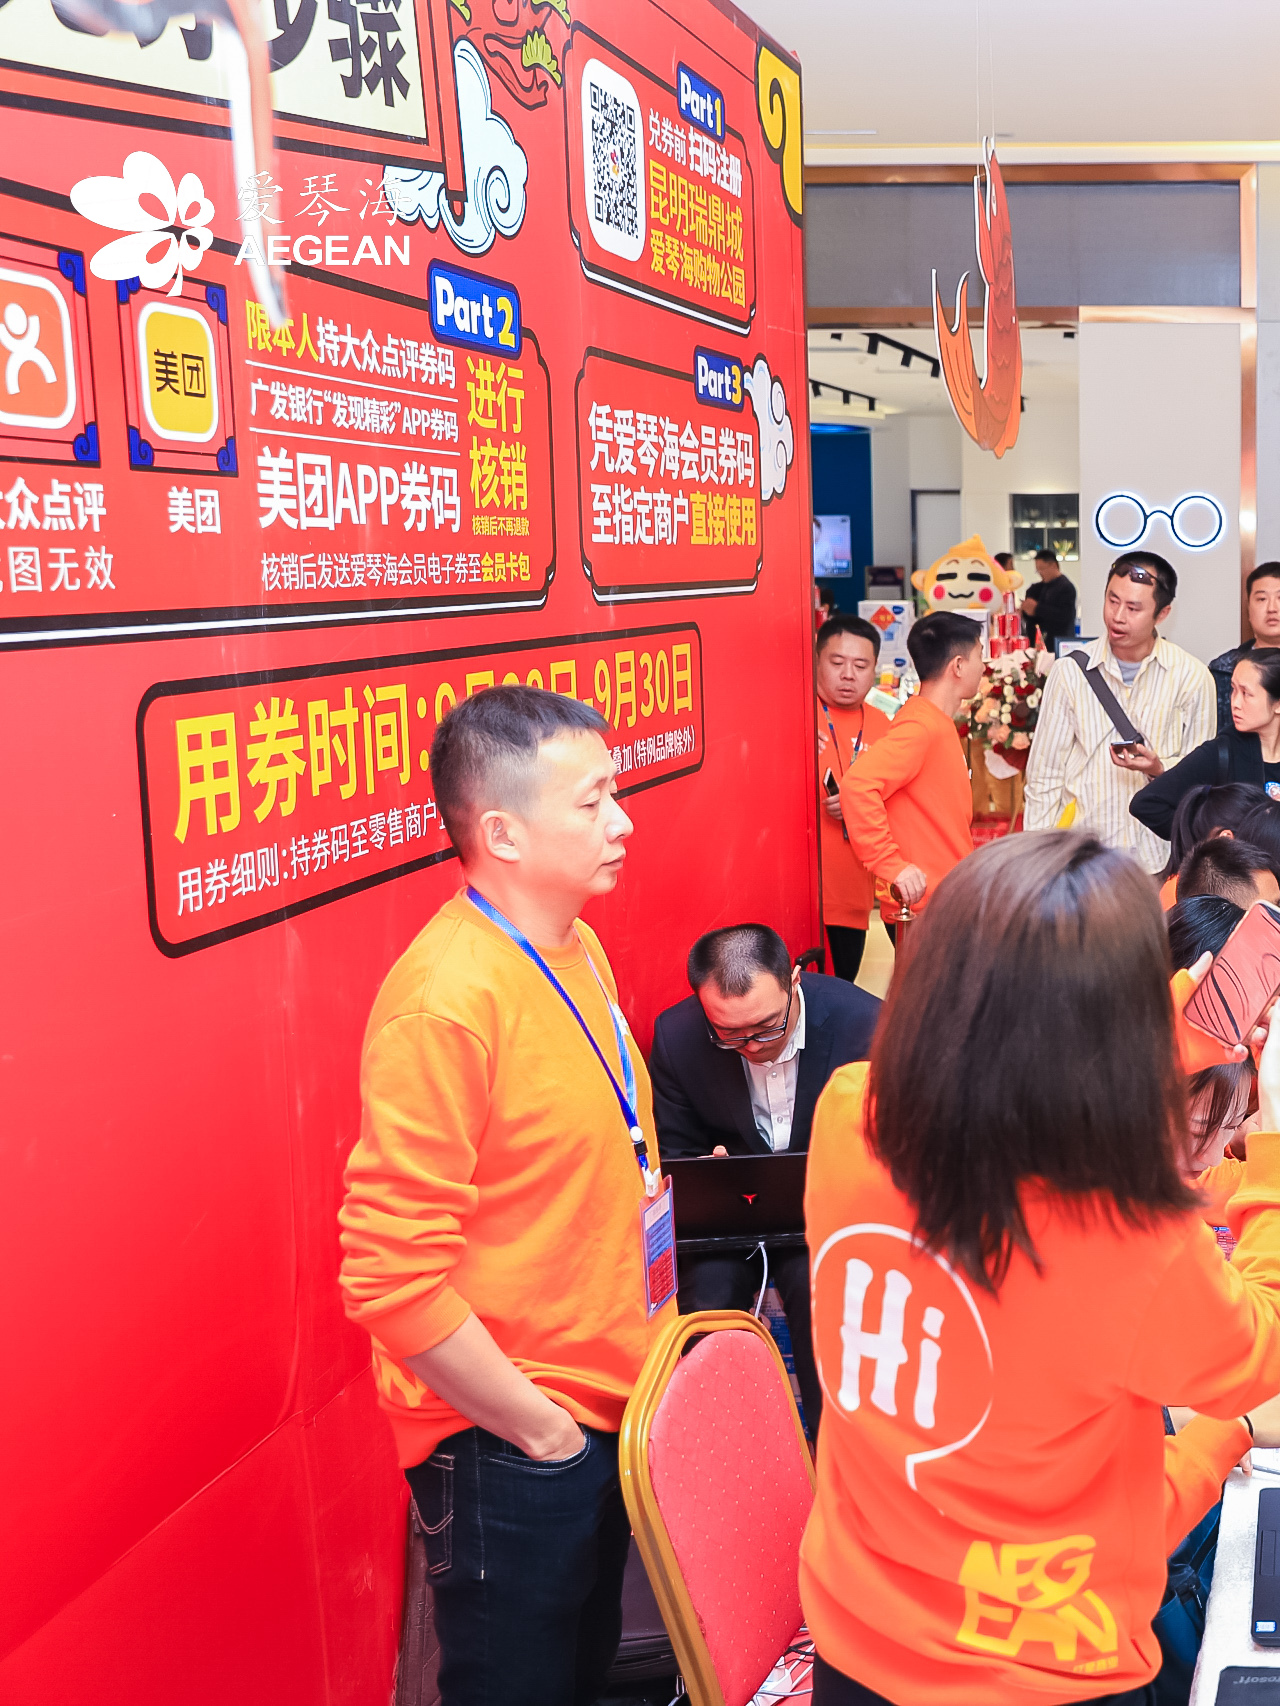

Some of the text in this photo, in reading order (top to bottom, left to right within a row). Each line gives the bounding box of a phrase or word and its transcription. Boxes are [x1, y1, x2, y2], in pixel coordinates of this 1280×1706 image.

[649, 107, 743, 198] 兑券前 扫码注册
[649, 159, 744, 262] 昆明瑞鼎城
[651, 229, 746, 308] 爱琴海购物公园
[154, 349, 206, 398] 美团
[245, 300, 456, 389] 限本人持大众点评券码
[466, 356, 525, 434] 进行
[469, 436, 528, 511] 核销
[588, 401, 755, 488] 凭爱琴海会员券码
[0, 476, 107, 532] 众点评
[168, 486, 222, 535] 美团
[257, 446, 461, 533] 美团APP券码
[590, 484, 757, 546] 至指定商户直接使用
[0, 545, 116, 593] 图无效
[261, 552, 532, 591] 核销后发送爱琴海会员电子券至会员卡包
[177, 797, 447, 916] 用券细则:持券码至零售商户
[838, 1258, 945, 1429] Hi
